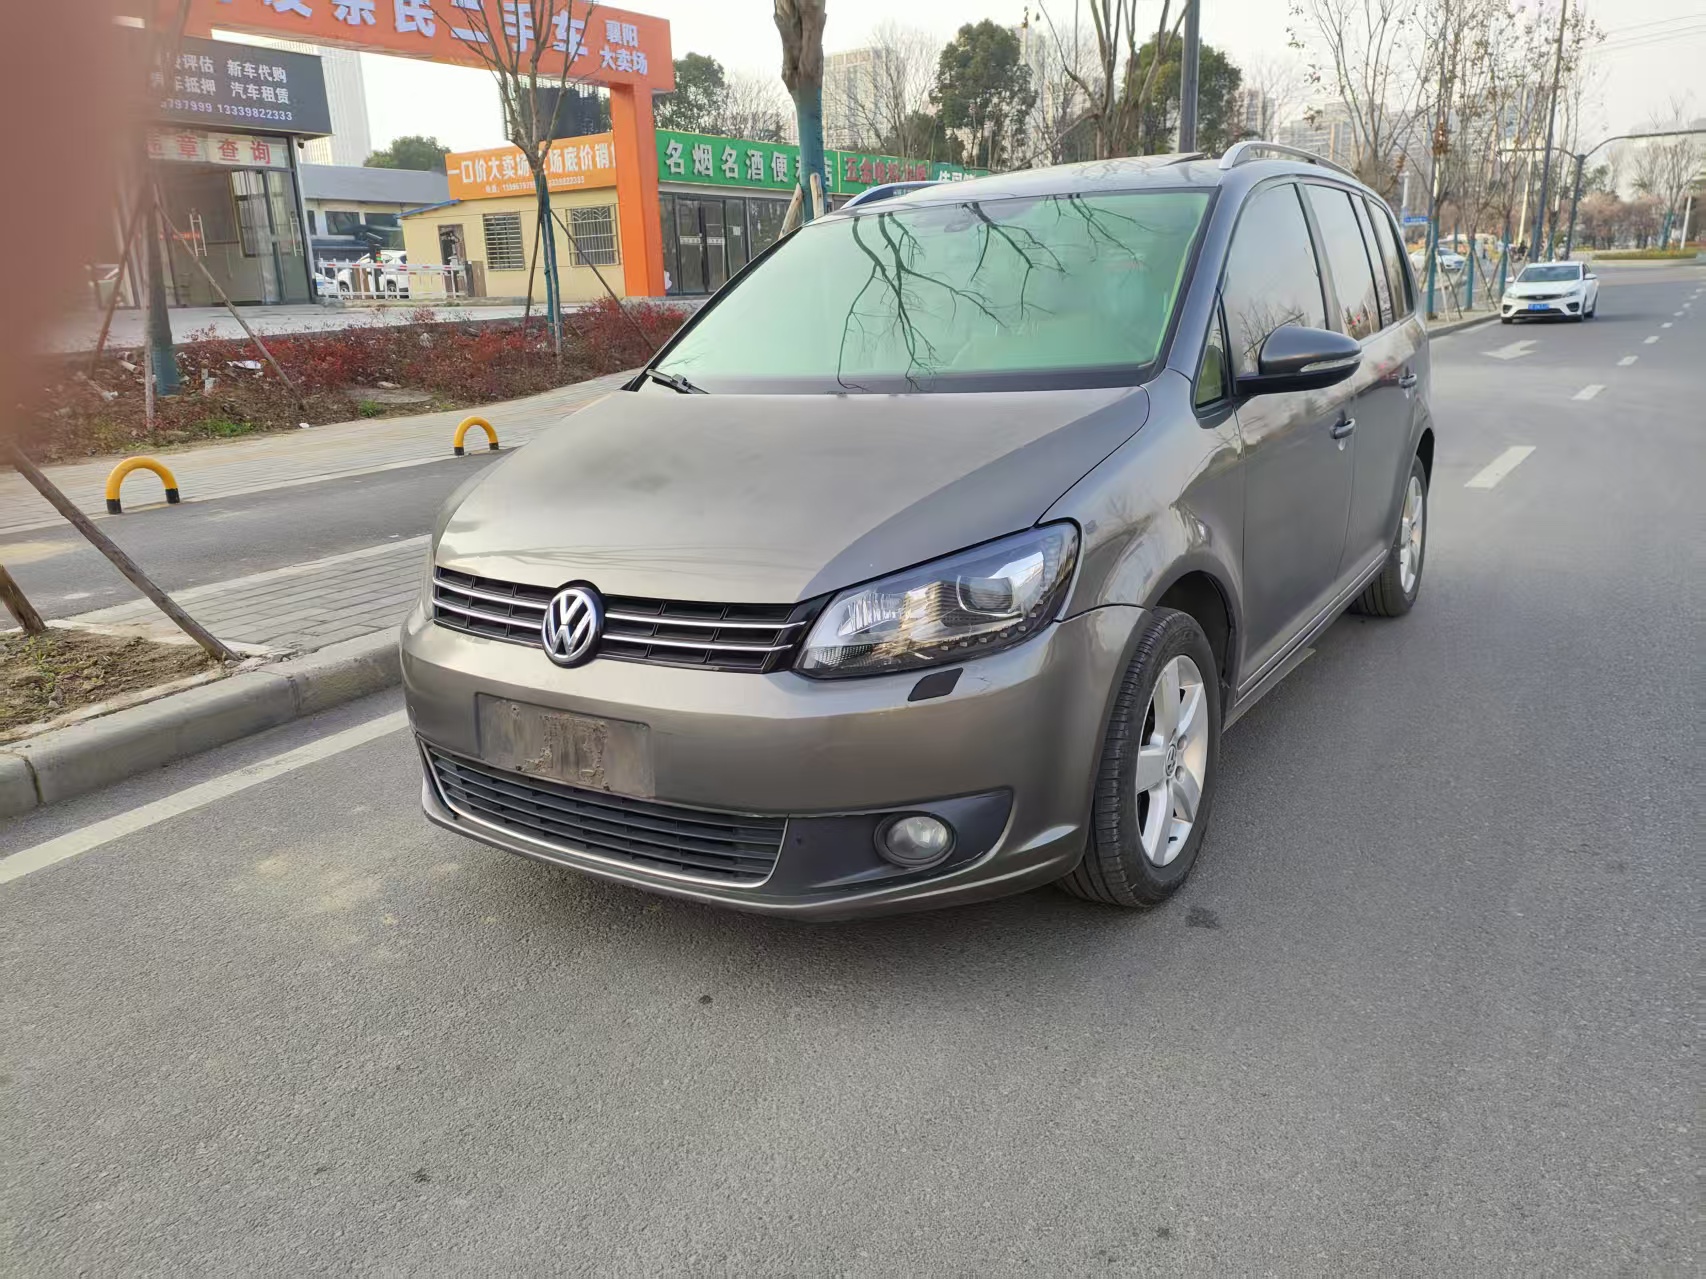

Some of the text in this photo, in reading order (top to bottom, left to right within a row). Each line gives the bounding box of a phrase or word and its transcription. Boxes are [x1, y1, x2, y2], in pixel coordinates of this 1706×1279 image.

[605, 19, 639, 48] 襄阳
[226, 59, 288, 84] 新车代购
[600, 46, 648, 75] 大卖场
[230, 81, 290, 105] 汽车租赁
[217, 103, 293, 121] 13339822333
[447, 141, 616, 184] 一口价大卖场场底价销
[665, 138, 833, 187] 名烟名酒便店
